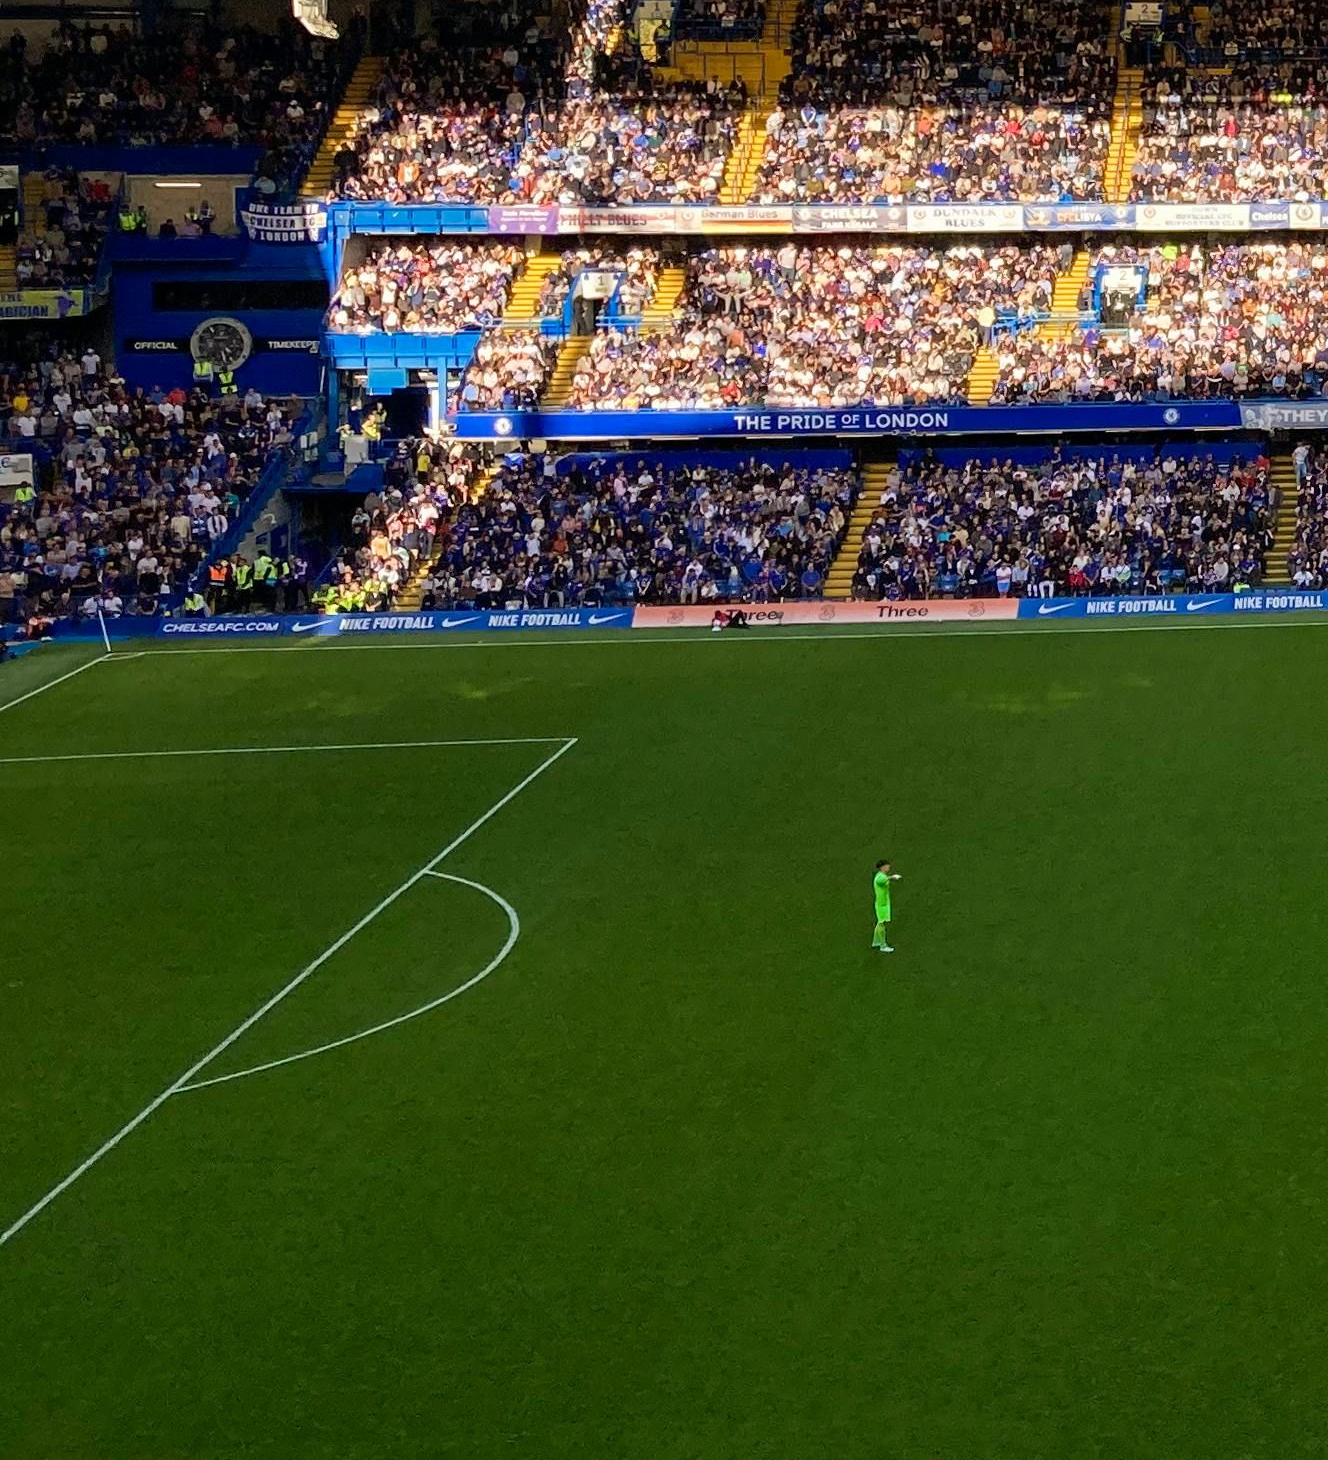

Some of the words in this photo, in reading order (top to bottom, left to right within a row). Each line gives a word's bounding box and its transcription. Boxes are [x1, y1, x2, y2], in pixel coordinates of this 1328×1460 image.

[747, 209, 779, 219] Blues
[821, 208, 878, 219] CHELSEA
[1251, 212, 1289, 222] Chelsea
[607, 214, 648, 227] BLUES
[945, 218, 985, 228] BLUES
[134, 341, 178, 350] OFFICIAL
[734, 416, 772, 430] THE
[777, 414, 837, 430] PRIDE
[840, 414, 860, 424] OF
[865, 413, 948, 429] LONDON
[1282, 409, 1328, 423] THEY
[1086, 601, 1115, 614] NIKE
[1118, 599, 1177, 613] FOOTBALL
[1234, 596, 1263, 611] NIKE
[1265, 595, 1324, 609] FOOTBALL
[726, 609, 778, 622] Tree
[876, 605, 929, 618] Three
[162, 620, 280, 634] CHELSEAFC.COM
[338, 617, 371, 631] NIKE
[372, 615, 435, 630] FOOTBALL
[487, 614, 519, 628] NIKE
[520, 612, 583, 627] FOOTBALL
